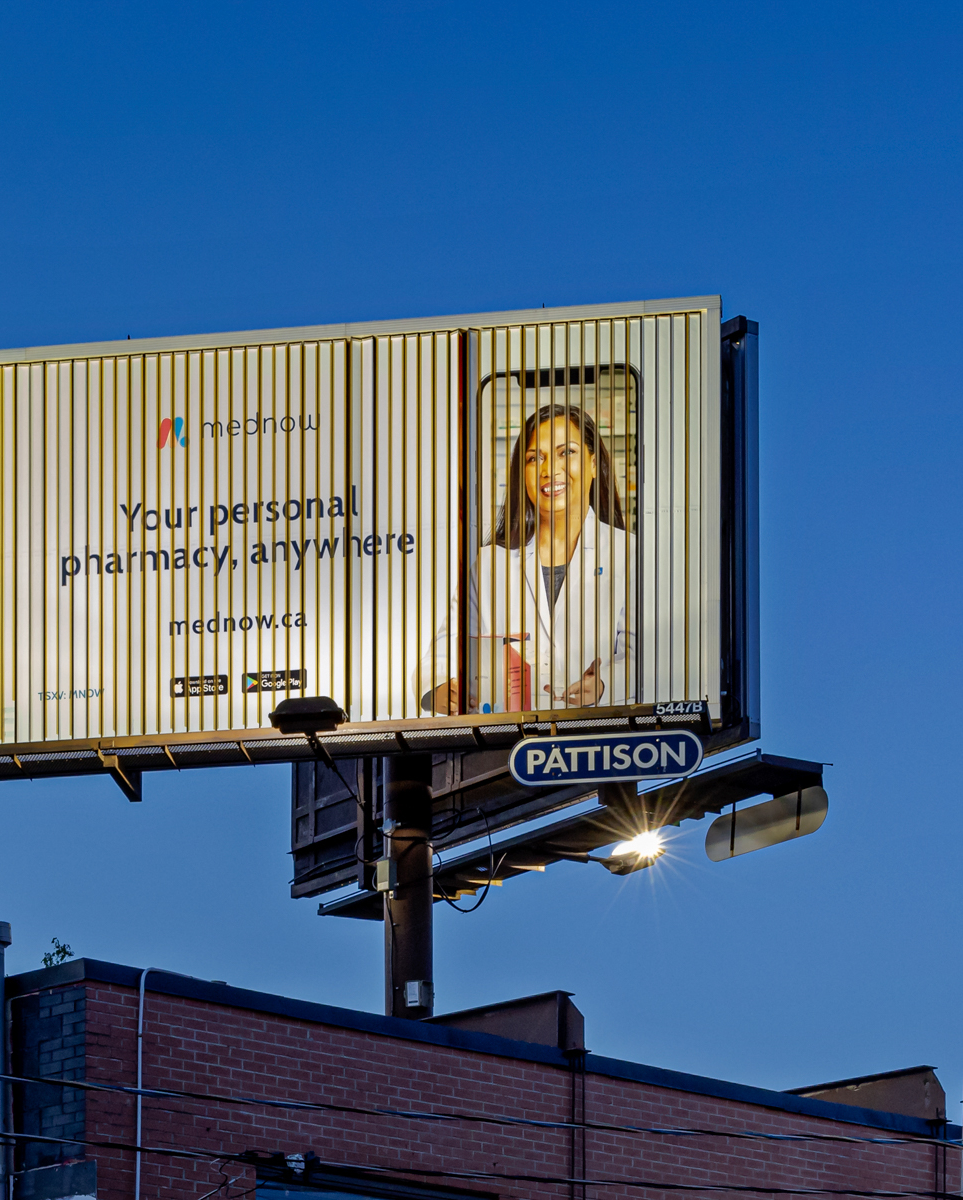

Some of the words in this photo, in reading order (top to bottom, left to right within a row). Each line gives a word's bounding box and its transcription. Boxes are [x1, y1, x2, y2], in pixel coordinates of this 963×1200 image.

[202, 412, 321, 438] mednow
[120, 502, 198, 531] Your
[210, 485, 358, 535] personal
[61, 544, 238, 586] pharmacy,
[250, 527, 415, 570] anywhere
[169, 611, 308, 636] mednow.ca
[261, 678, 286, 689] Google
[288, 678, 302, 688] Play
[656, 701, 703, 715] 5447B
[526, 741, 686, 775] PATTISON
